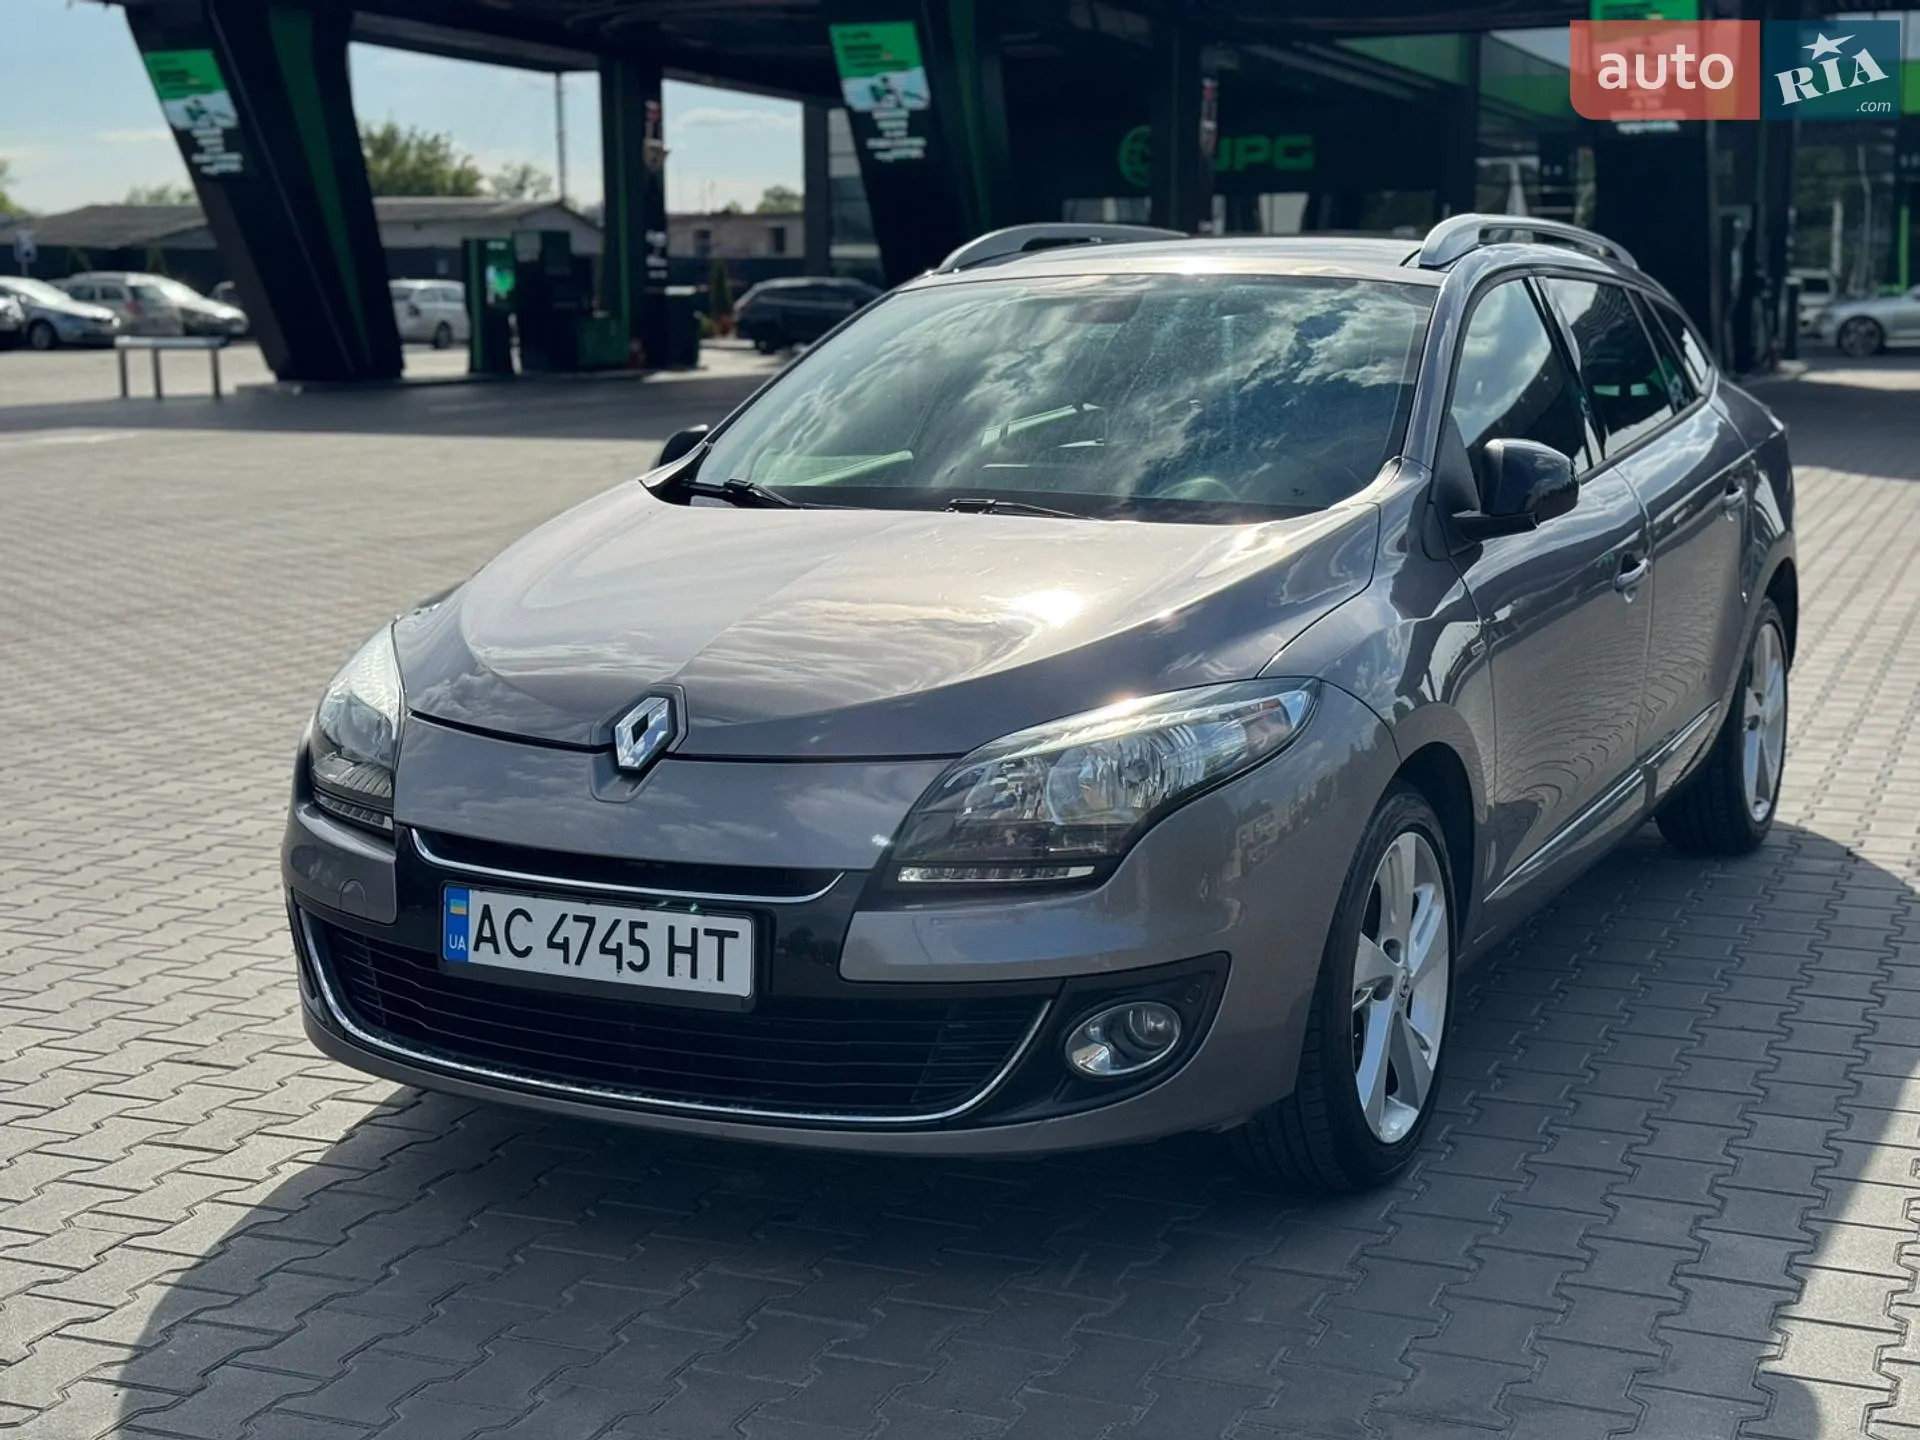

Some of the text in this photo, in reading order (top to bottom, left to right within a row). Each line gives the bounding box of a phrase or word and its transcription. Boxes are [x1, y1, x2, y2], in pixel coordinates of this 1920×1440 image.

[449, 933, 467, 952] UA
[472, 903, 740, 982] AC 4745 HT
